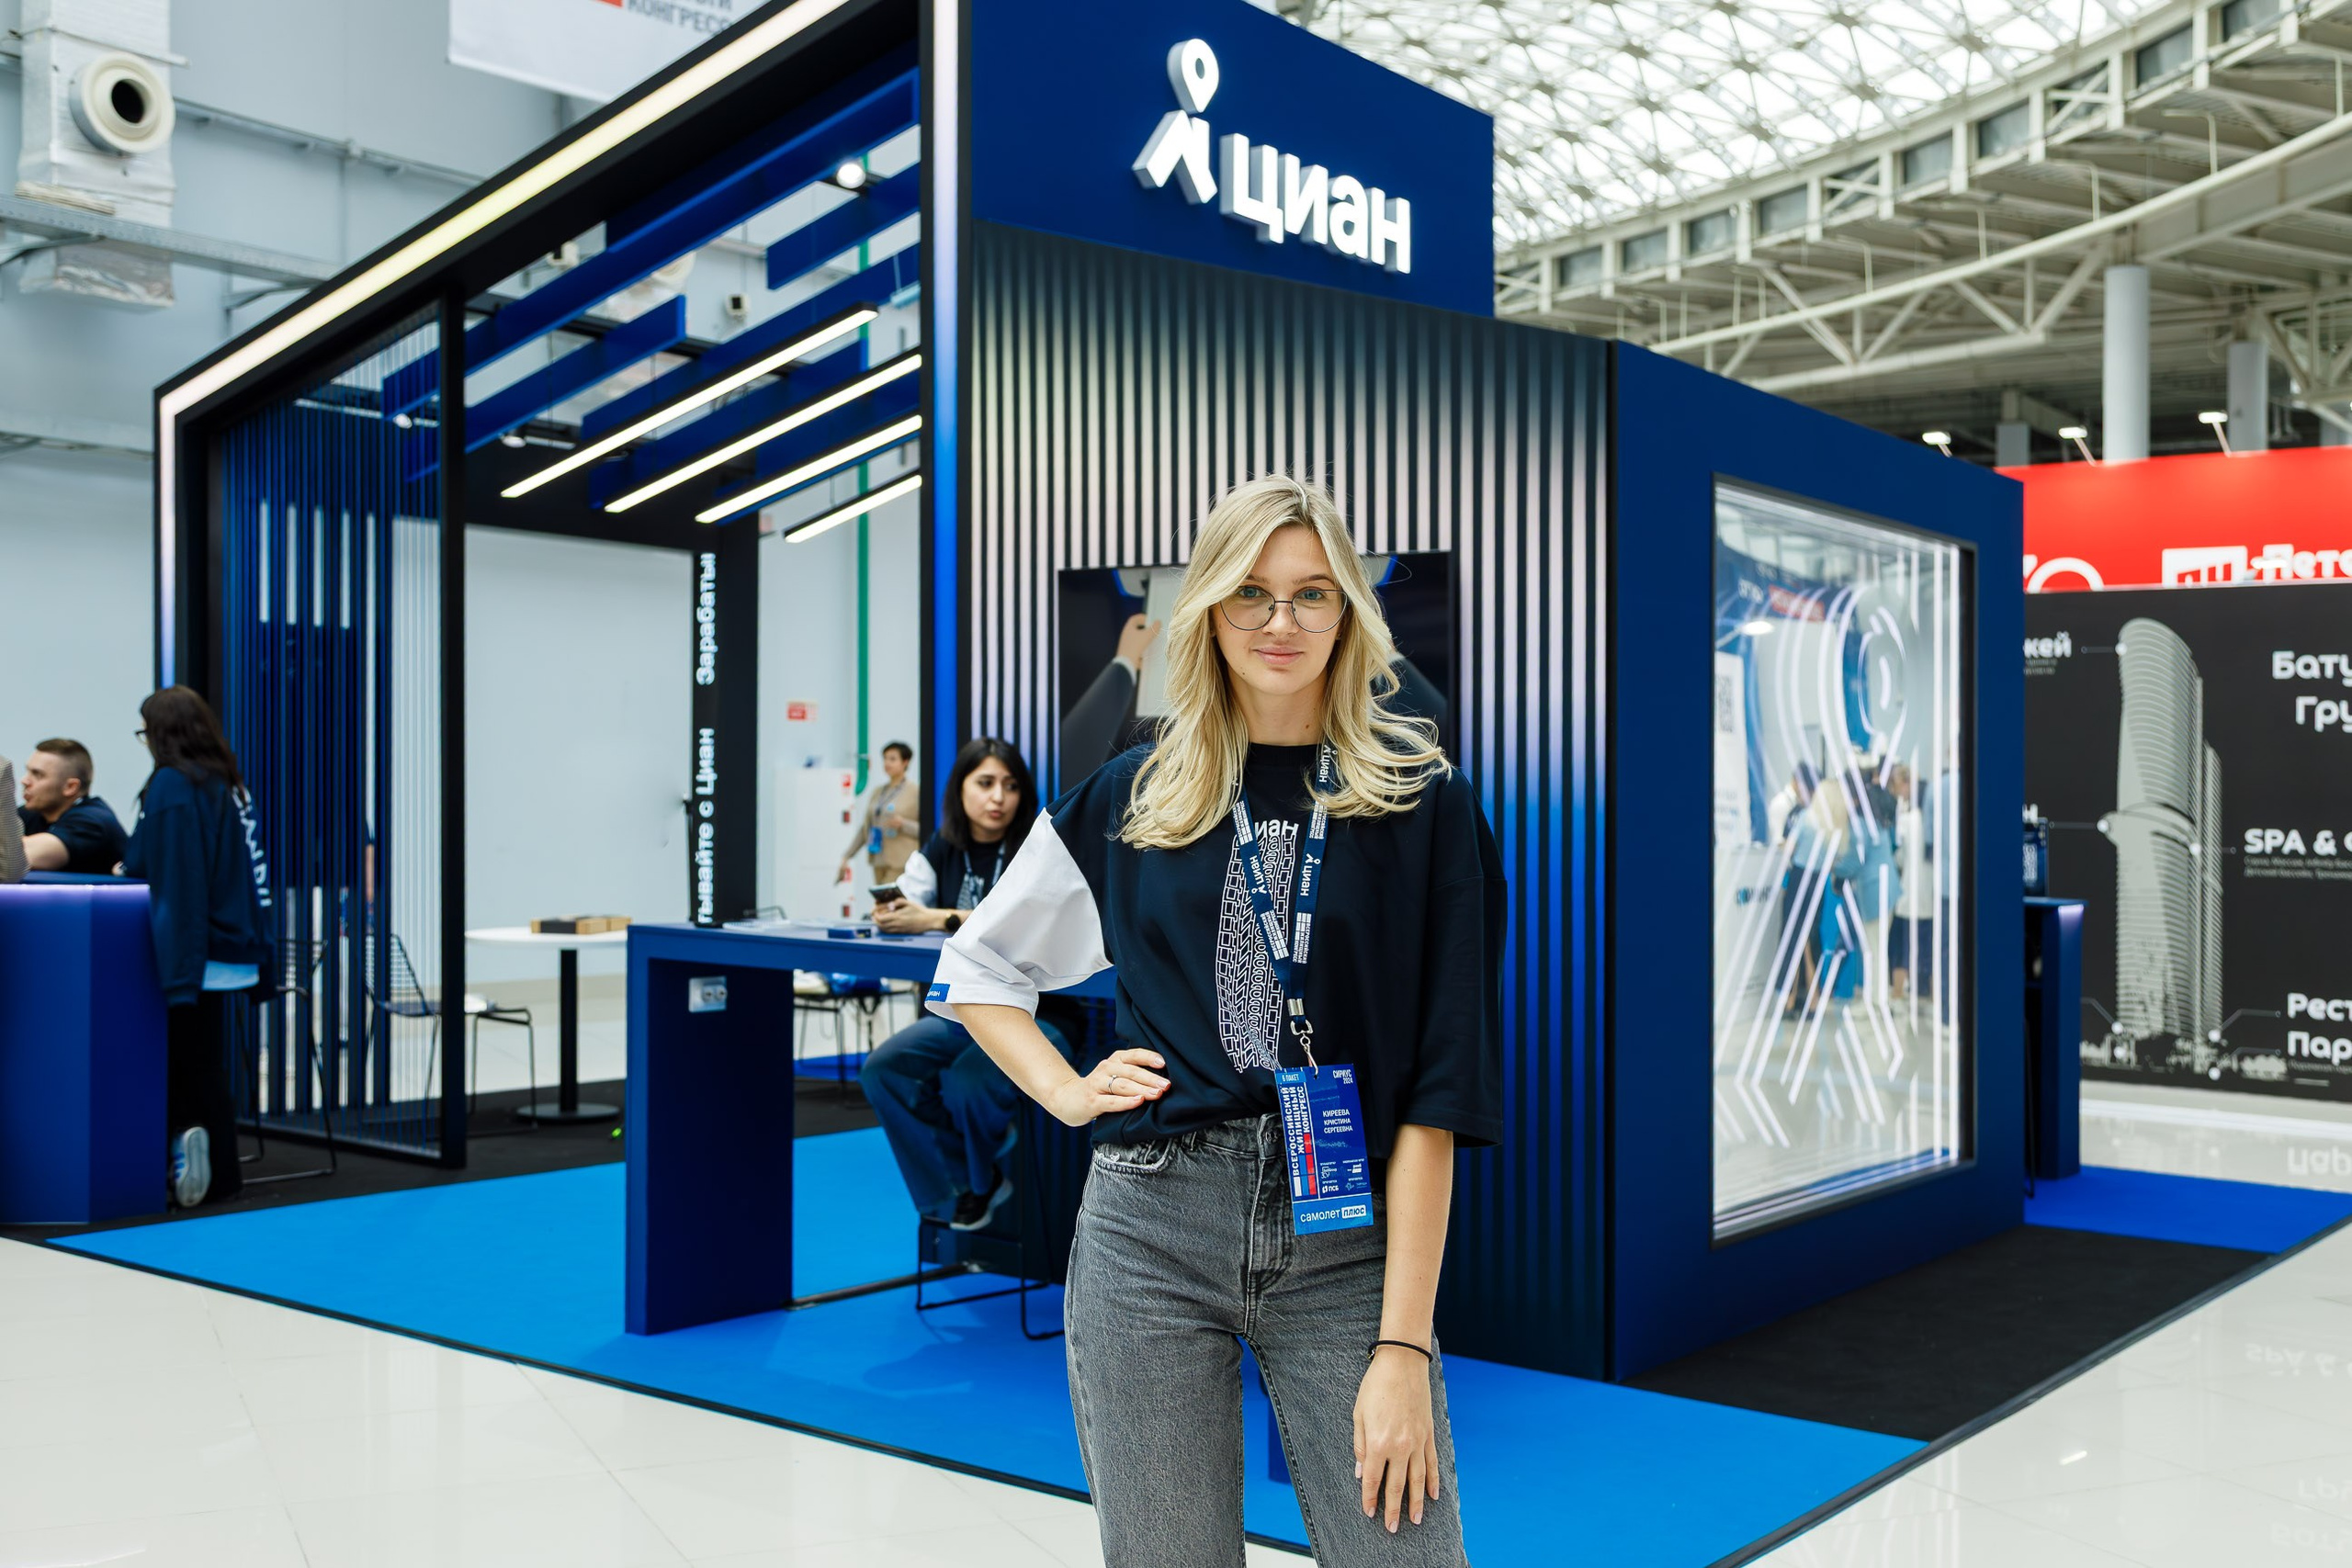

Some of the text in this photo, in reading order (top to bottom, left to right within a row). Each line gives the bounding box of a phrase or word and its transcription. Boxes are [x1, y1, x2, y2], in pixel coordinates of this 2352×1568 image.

[1219, 132, 1411, 274] циан
[2023, 630, 2072, 659] кей
[695, 728, 718, 795] Циан
[1254, 818, 1300, 840] иан
[2245, 828, 2307, 855] SPA
[1250, 855, 1266, 885] циан
[1300, 865, 1313, 897] циан
[2288, 1031, 2352, 1066] Пар
[1332, 1069, 1352, 1078] СИРИУС
[1287, 1086, 1306, 1154] ЖИЛИЩНЫЙ
[1296, 1086, 1310, 1133] КОНГРЕСС
[1322, 1109, 1350, 1117] КИРЕЕВА
[1323, 1118, 1351, 1126] КРИСТИНА
[1281, 1086, 1300, 1176] ВСЕРОССИЙСКИЙ
[1323, 1125, 1353, 1134] СЕРГЕЕВНА
[1300, 1208, 1341, 1223] самолет
